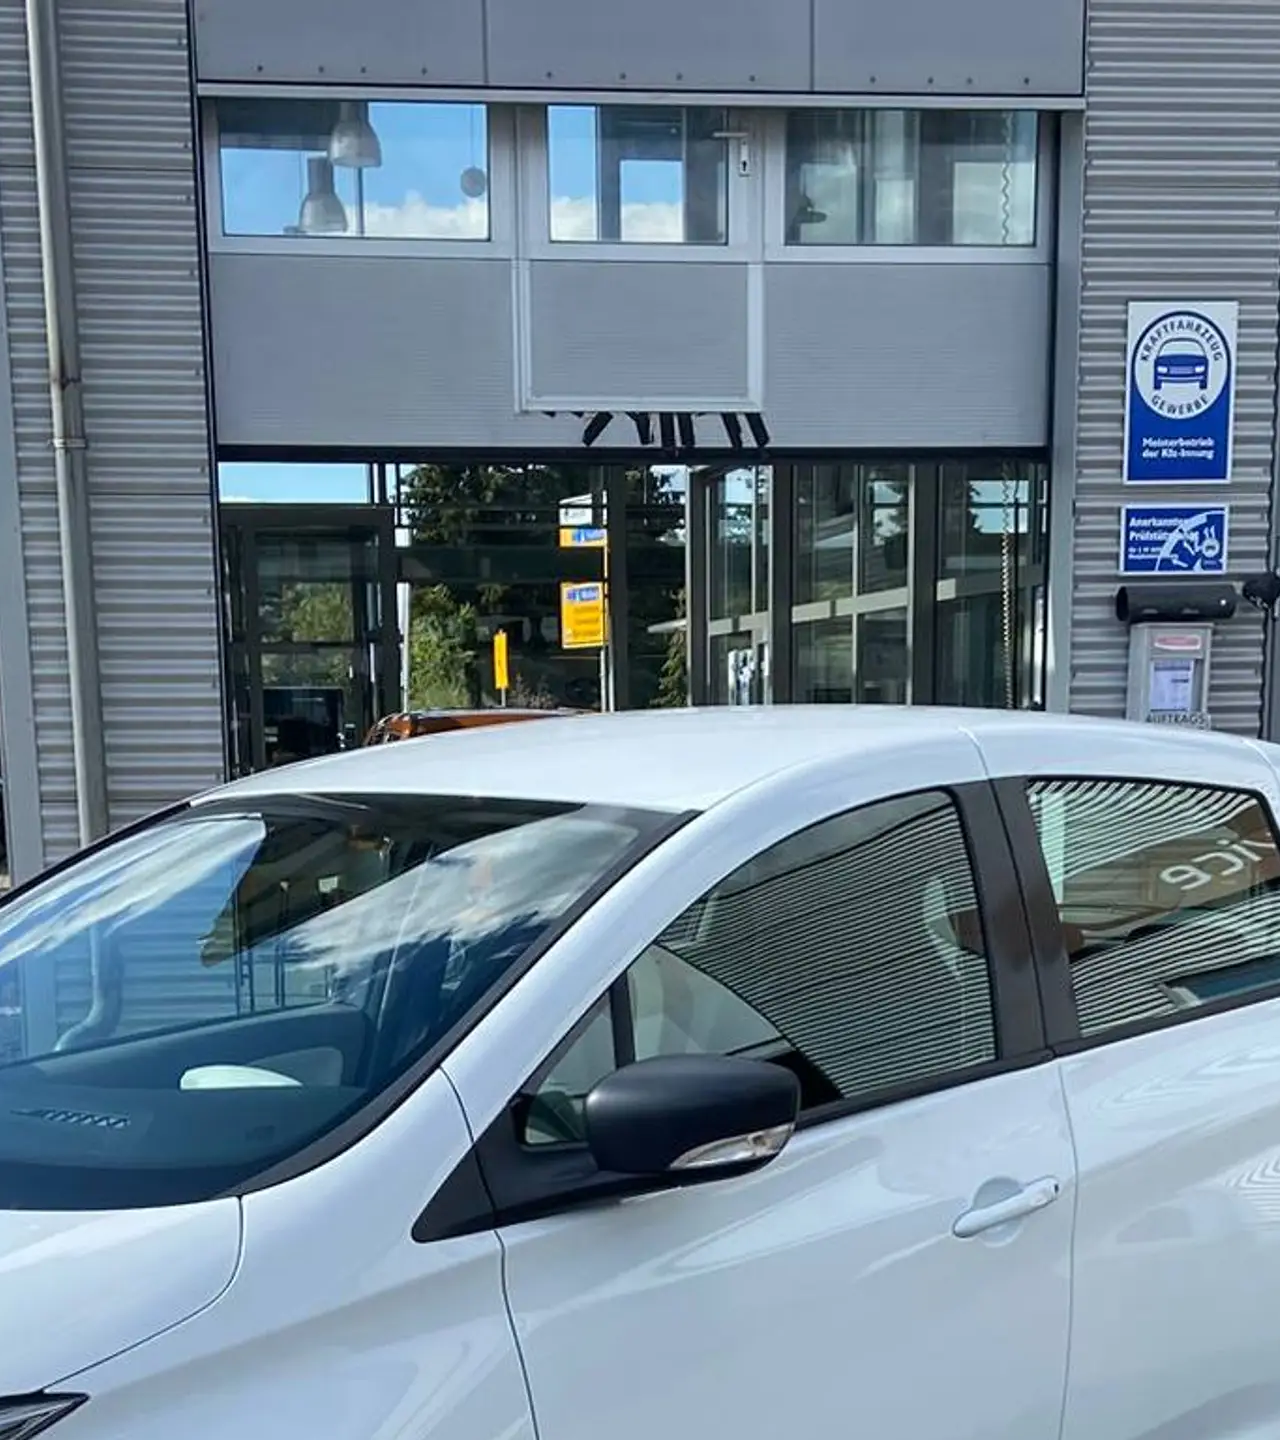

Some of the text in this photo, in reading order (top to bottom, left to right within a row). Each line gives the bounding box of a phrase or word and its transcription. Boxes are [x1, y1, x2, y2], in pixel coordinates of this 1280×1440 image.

[1140, 319, 1224, 362] KRAFTFAHRZEUG
[1151, 394, 1209, 416] GEWERBE
[1142, 437, 1215, 448] Meisterbetrieb
[1142, 449, 1159, 459] der
